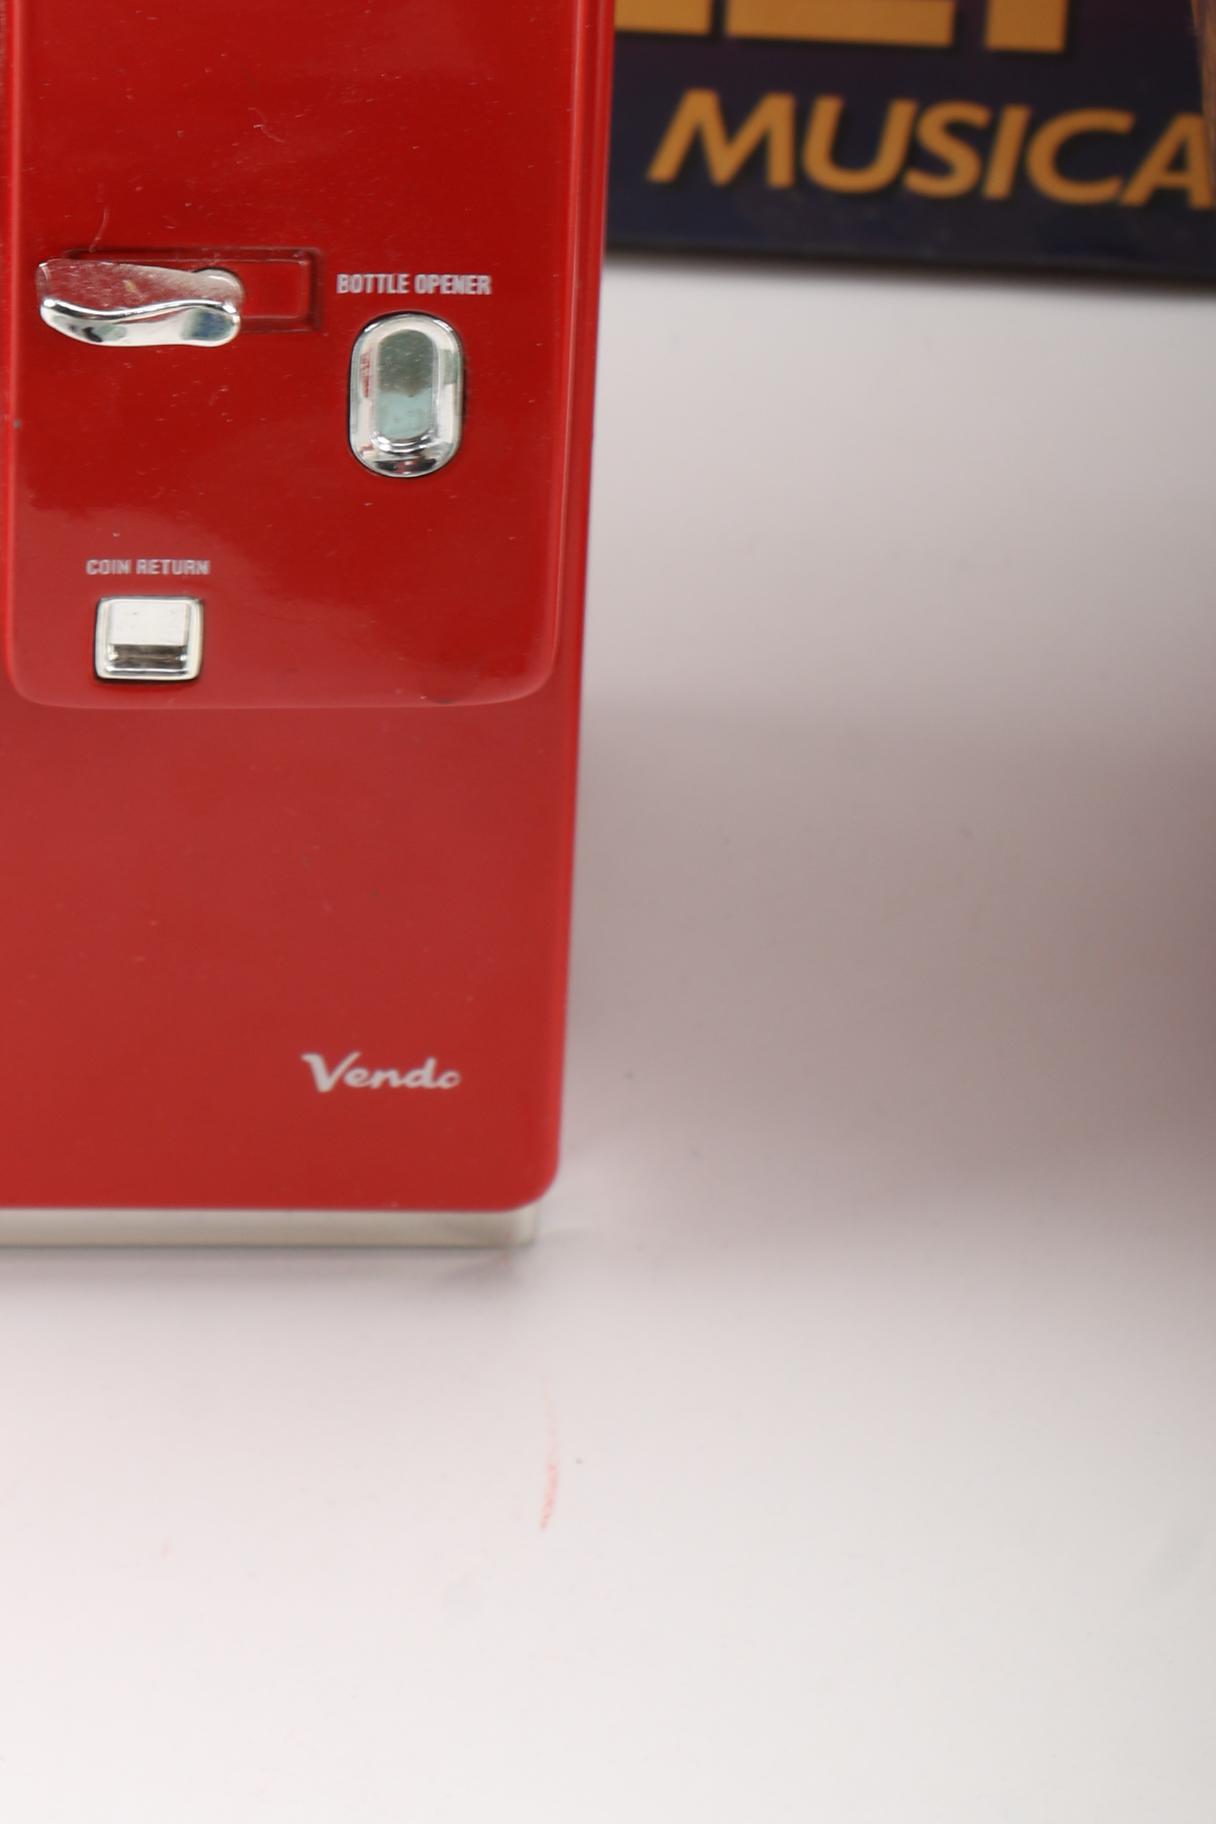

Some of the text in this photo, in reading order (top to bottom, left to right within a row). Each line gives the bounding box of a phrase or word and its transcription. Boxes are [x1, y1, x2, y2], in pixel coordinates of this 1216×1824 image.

[336, 274, 492, 296] BOTTLE OPENER
[86, 559, 210, 576] COIN RETURN
[300, 1050, 462, 1093] Vendo
